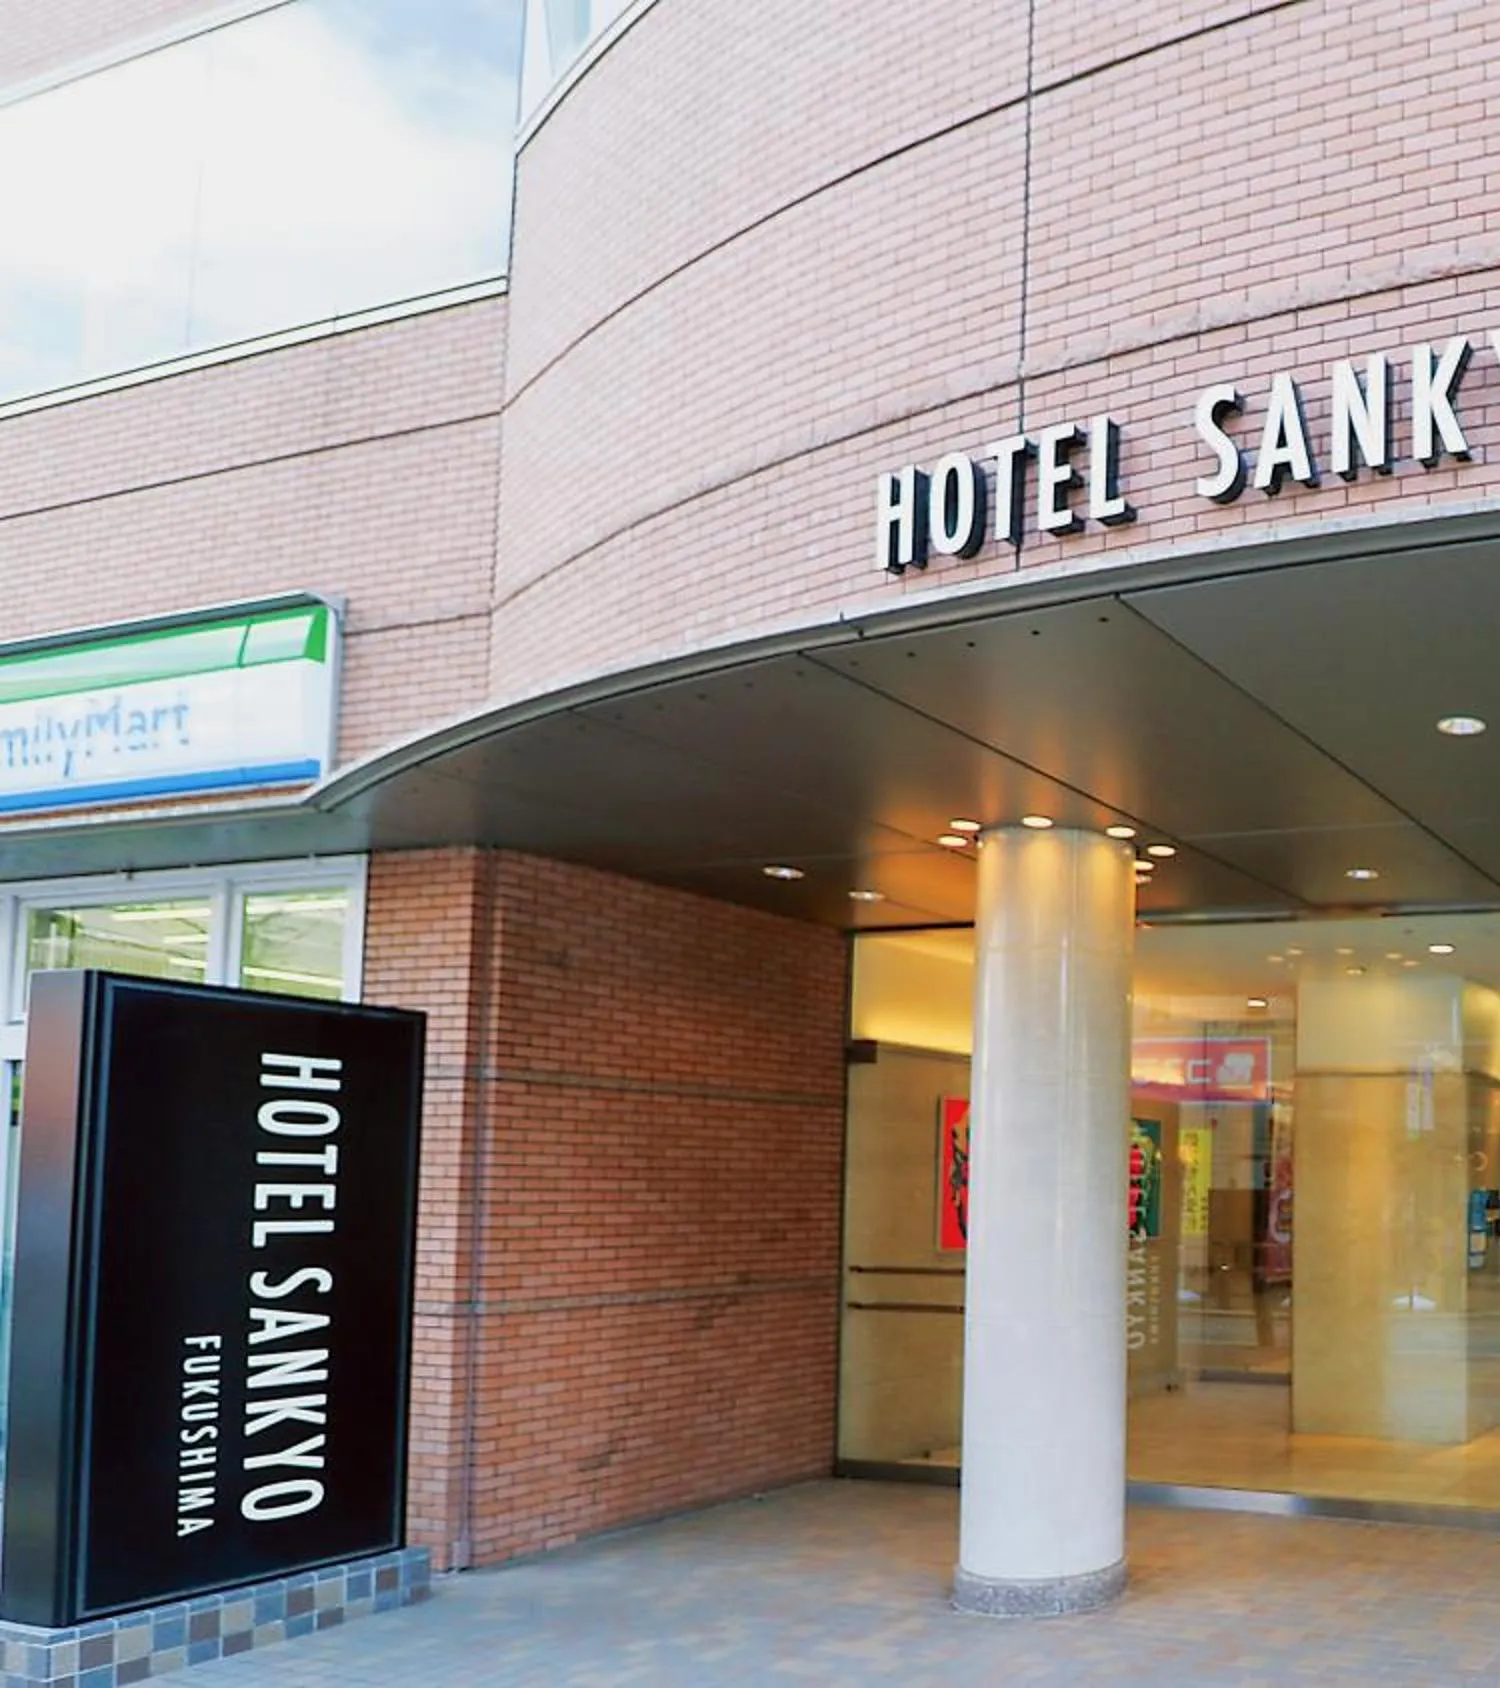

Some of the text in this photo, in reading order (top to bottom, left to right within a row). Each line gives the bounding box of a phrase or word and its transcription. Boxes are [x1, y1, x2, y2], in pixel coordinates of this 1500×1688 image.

[876, 415, 1133, 573] HOTEL
[241, 1052, 343, 1522] HOTEL SANKYO
[177, 1335, 222, 1538] FUKUSHIMA
